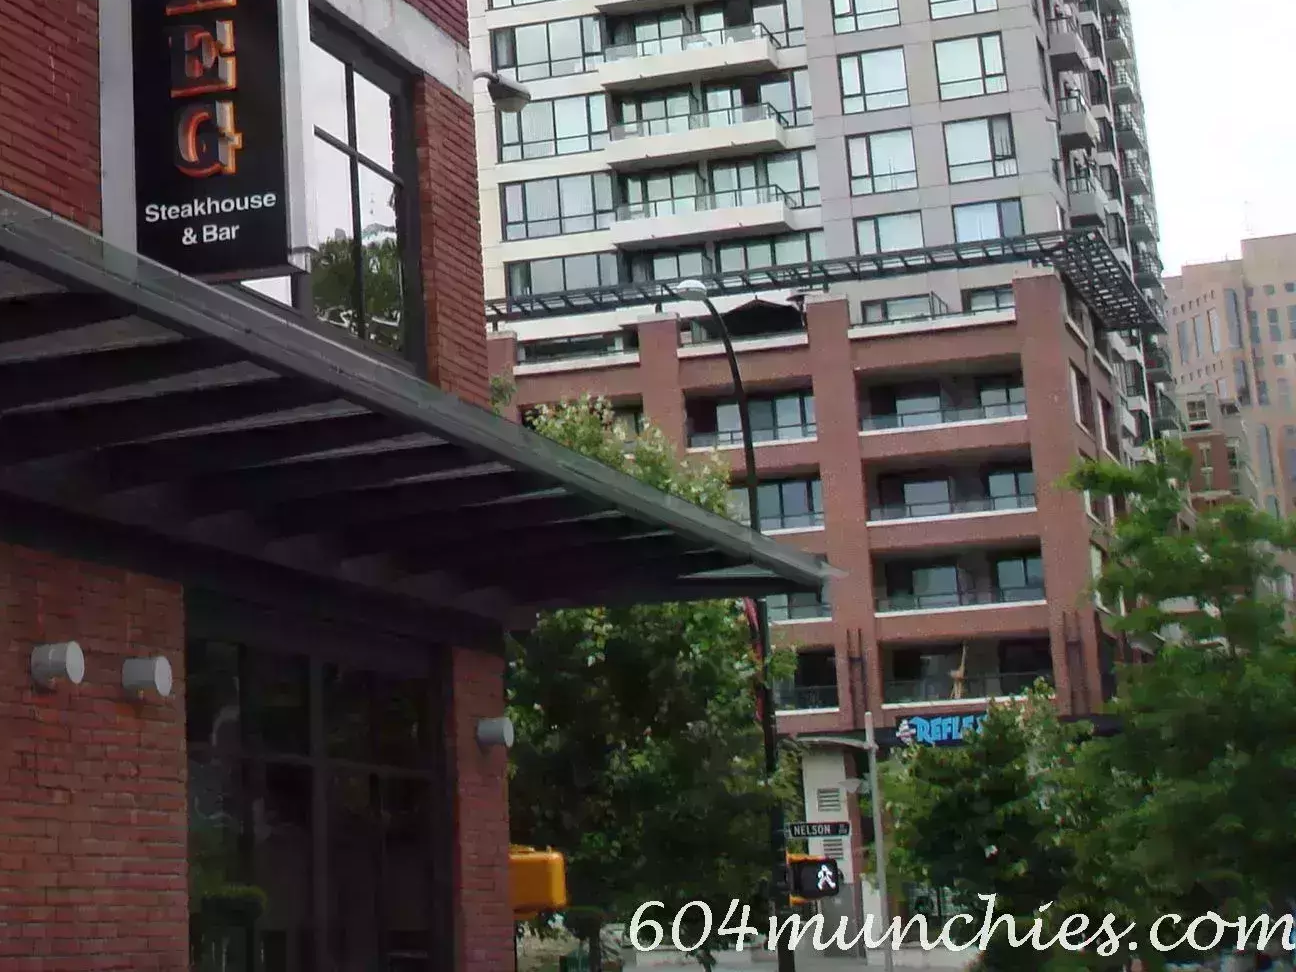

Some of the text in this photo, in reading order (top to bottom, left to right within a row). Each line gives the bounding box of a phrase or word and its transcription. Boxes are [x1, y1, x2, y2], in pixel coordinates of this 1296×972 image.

[144, 192, 277, 223] Steakhouse
[182, 223, 241, 246] & Bar
[793, 824, 831, 836] NELSON
